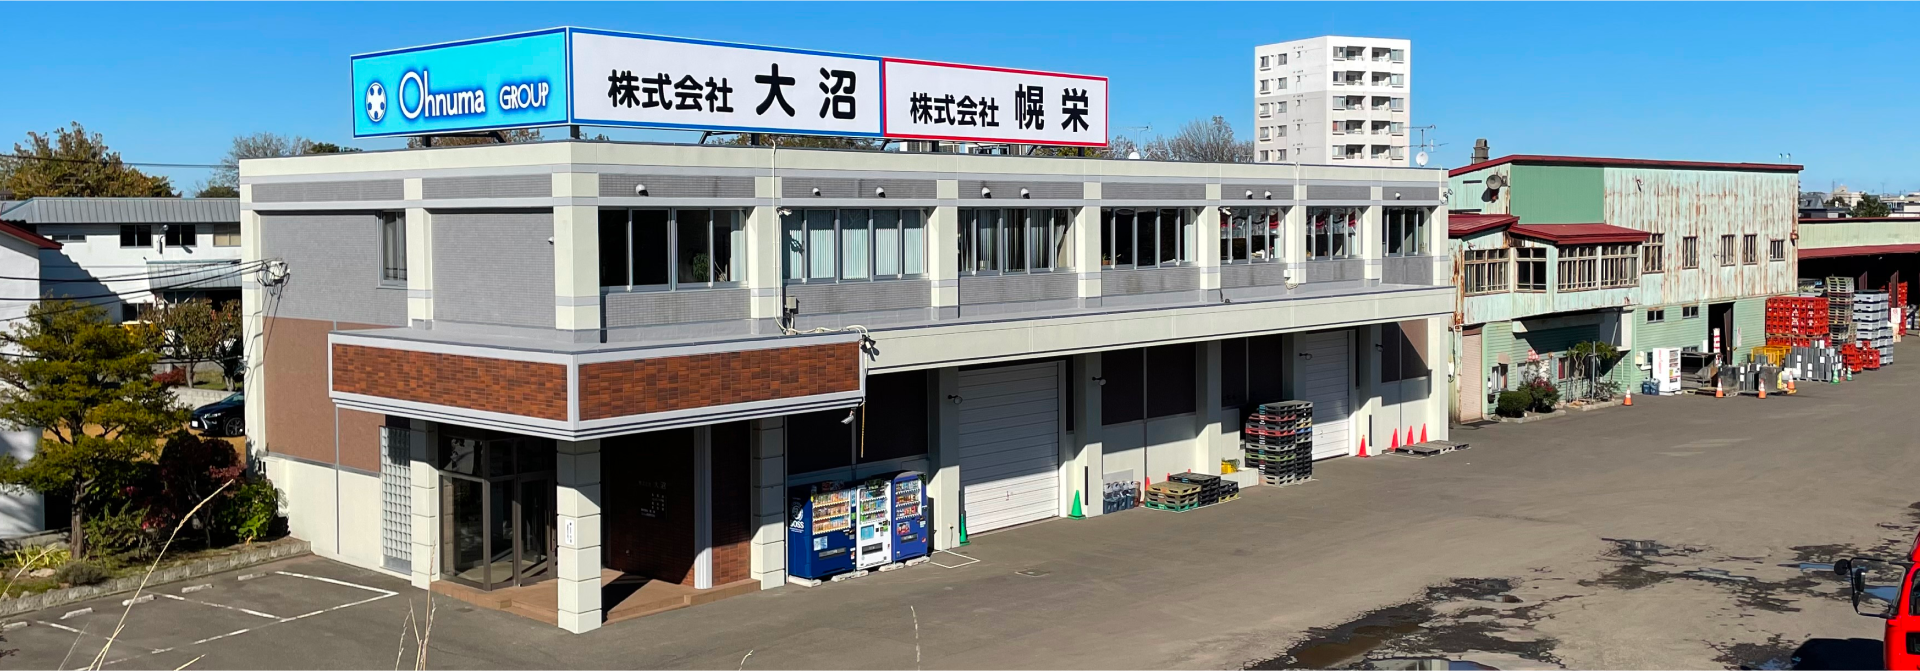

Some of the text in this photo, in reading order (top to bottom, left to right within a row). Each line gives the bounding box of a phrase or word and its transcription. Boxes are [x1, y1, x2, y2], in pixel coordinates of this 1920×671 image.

[399, 70, 550, 119] Ohnuma GROUP
[607, 69, 735, 113] 株式会社
[909, 91, 1000, 128] 株式会社
